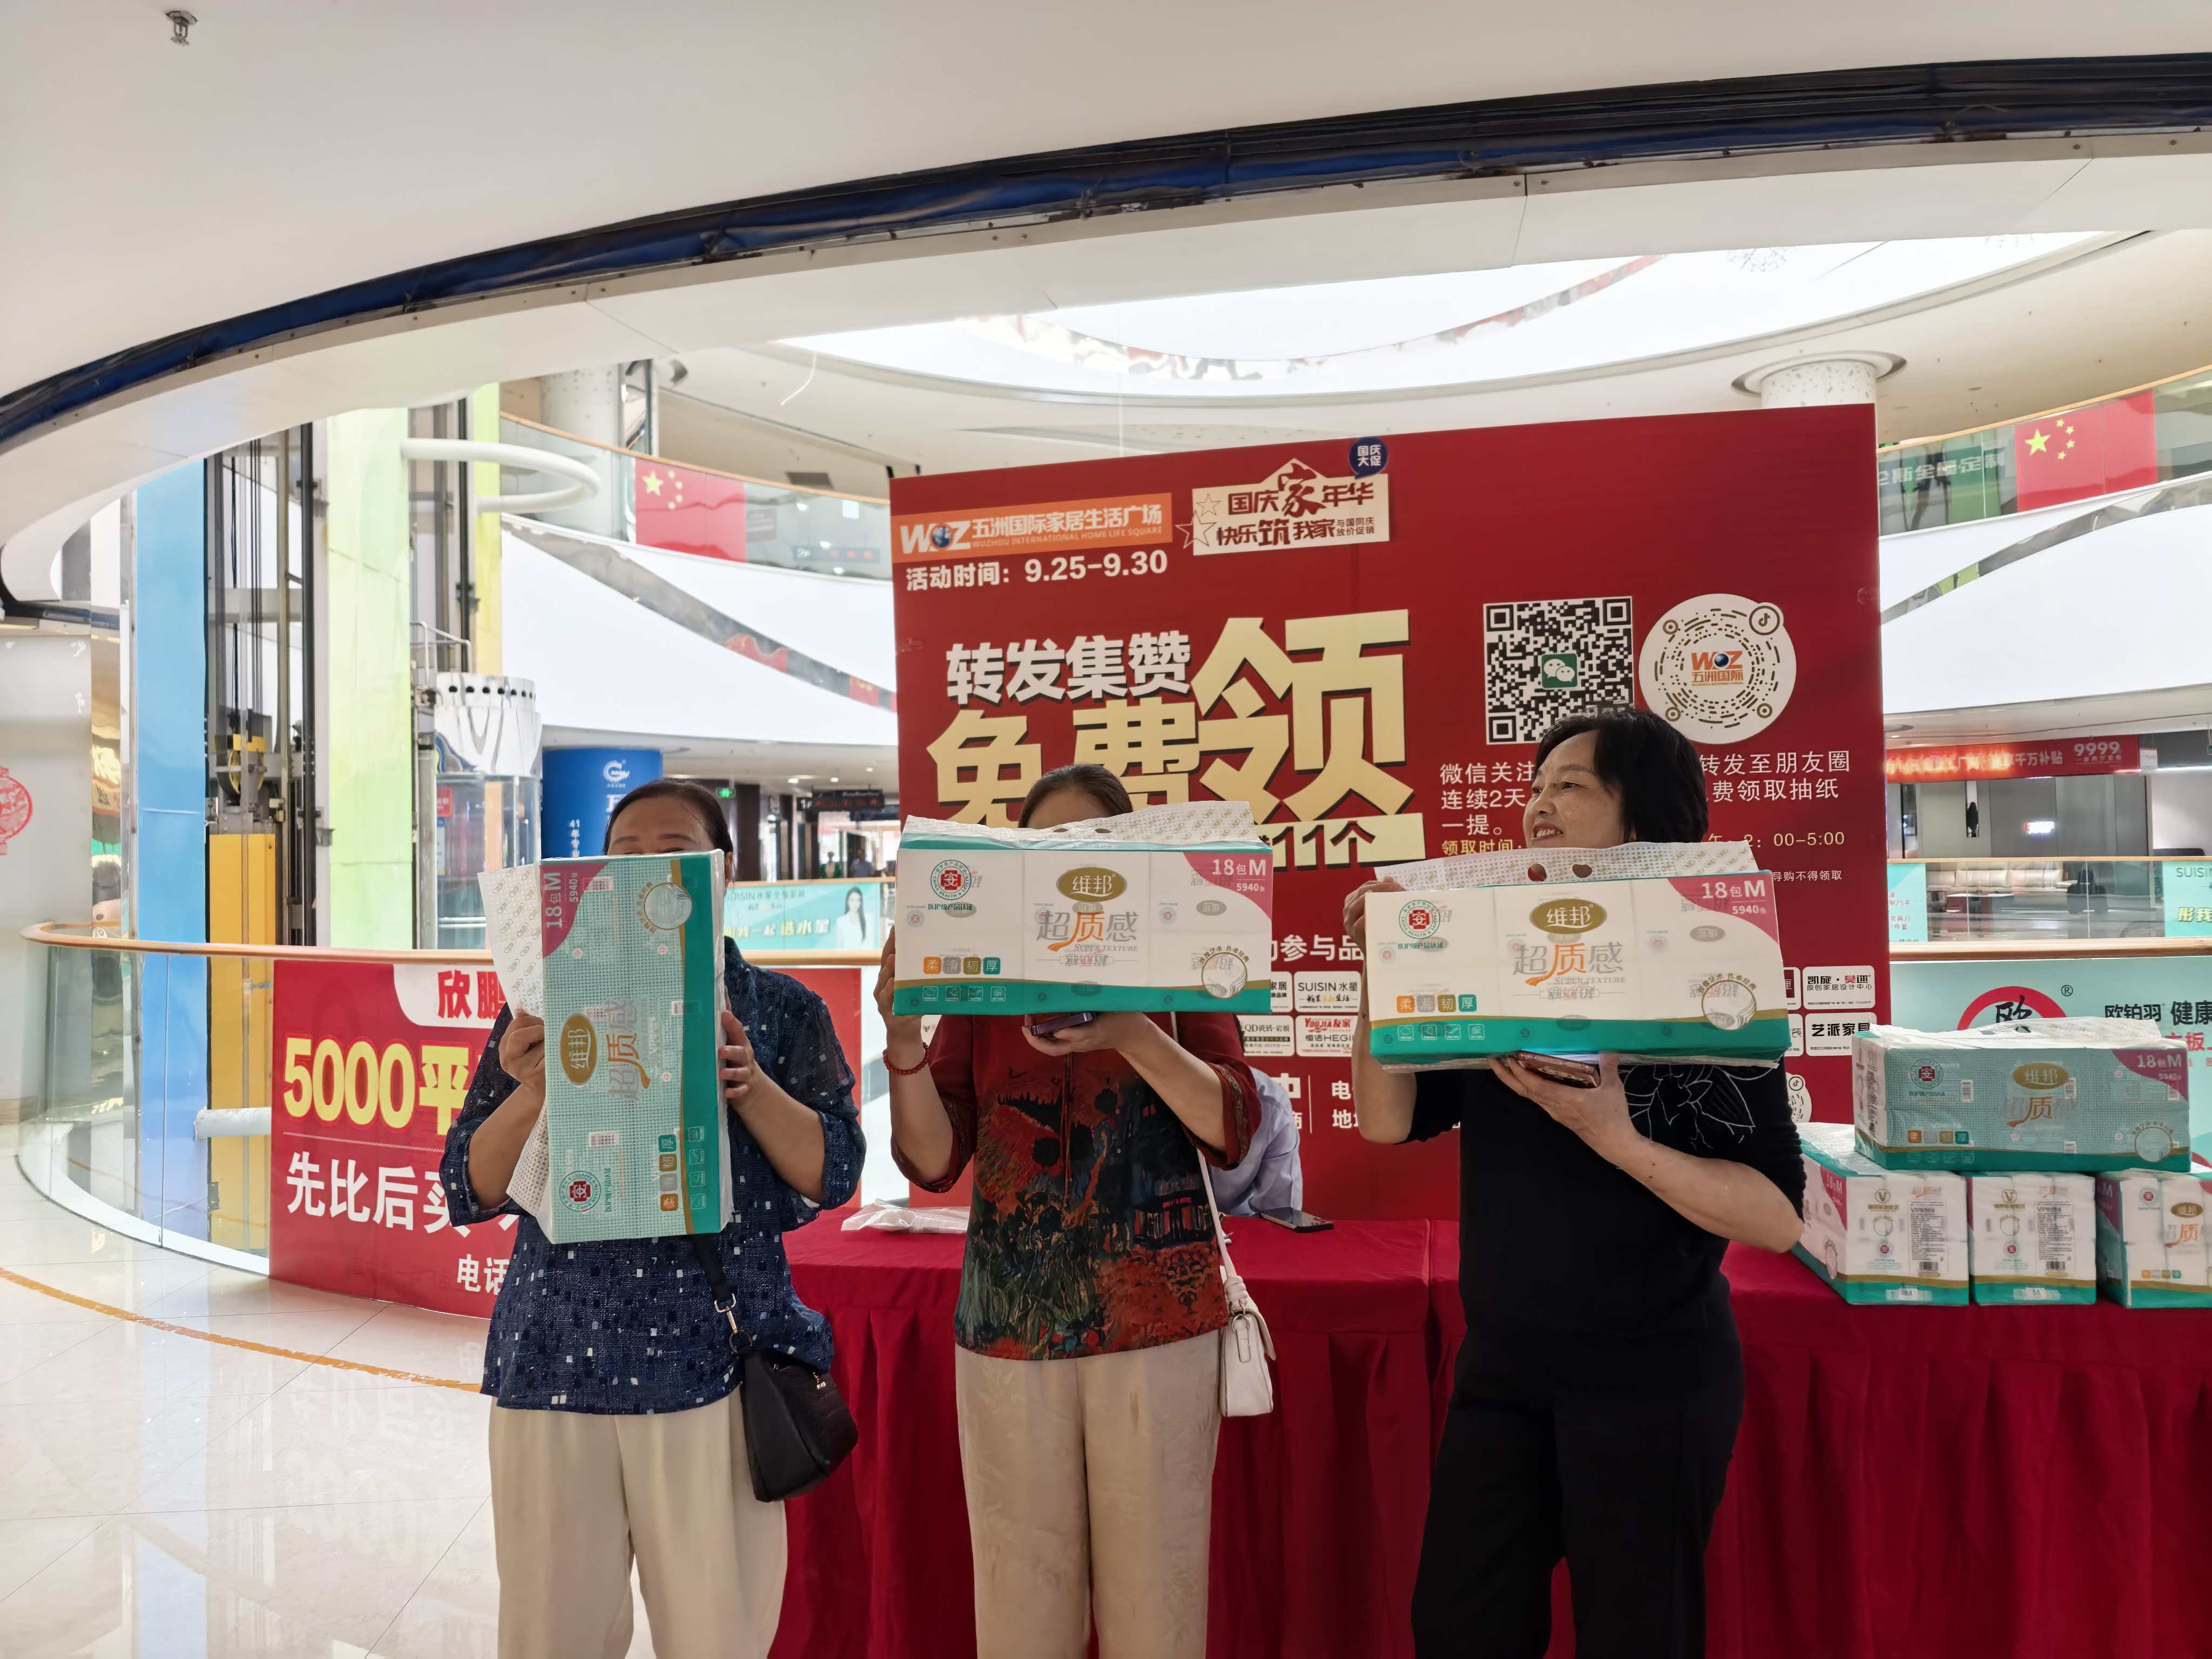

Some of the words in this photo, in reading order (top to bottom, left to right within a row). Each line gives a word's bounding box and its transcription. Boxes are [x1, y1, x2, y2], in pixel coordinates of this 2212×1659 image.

[1357, 445, 1381, 456] 国庆
[1358, 456, 1382, 467] 大促
[1228, 463, 1374, 518] 国庆家年华
[972, 504, 1163, 539] 五洲国际家居生活广场
[1337, 517, 1374, 527] 与国同庆
[1337, 527, 1375, 536] 放价促销
[1011, 534, 1080, 545] INTERNATIONAL
[1081, 530, 1107, 539] HOME
[1109, 529, 1126, 537] LIFE
[1128, 526, 1163, 536] SQUARE
[1216, 518, 1336, 547] 快乐筑我家
[946, 630, 1191, 705] 转发集赞
[2074, 741, 2120, 757] 9999
[1441, 788, 1526, 810] 连续2天
[1441, 814, 1502, 835] 一提。
[1212, 859, 1266, 876] 18包M
[1773, 870, 1843, 882] 导购不得领取
[1072, 875, 1113, 895] 维邦
[1702, 879, 1766, 899] 18包M
[1546, 906, 1590, 925] 维邦
[1035, 910, 1139, 952] 超质感
[1512, 941, 1624, 987] 超质感
[1298, 982, 1337, 992] SUISIN
[1339, 982, 1358, 992] 水星
[570, 1029, 591, 1070] 维邦
[605, 996, 651, 1102] 超质感
